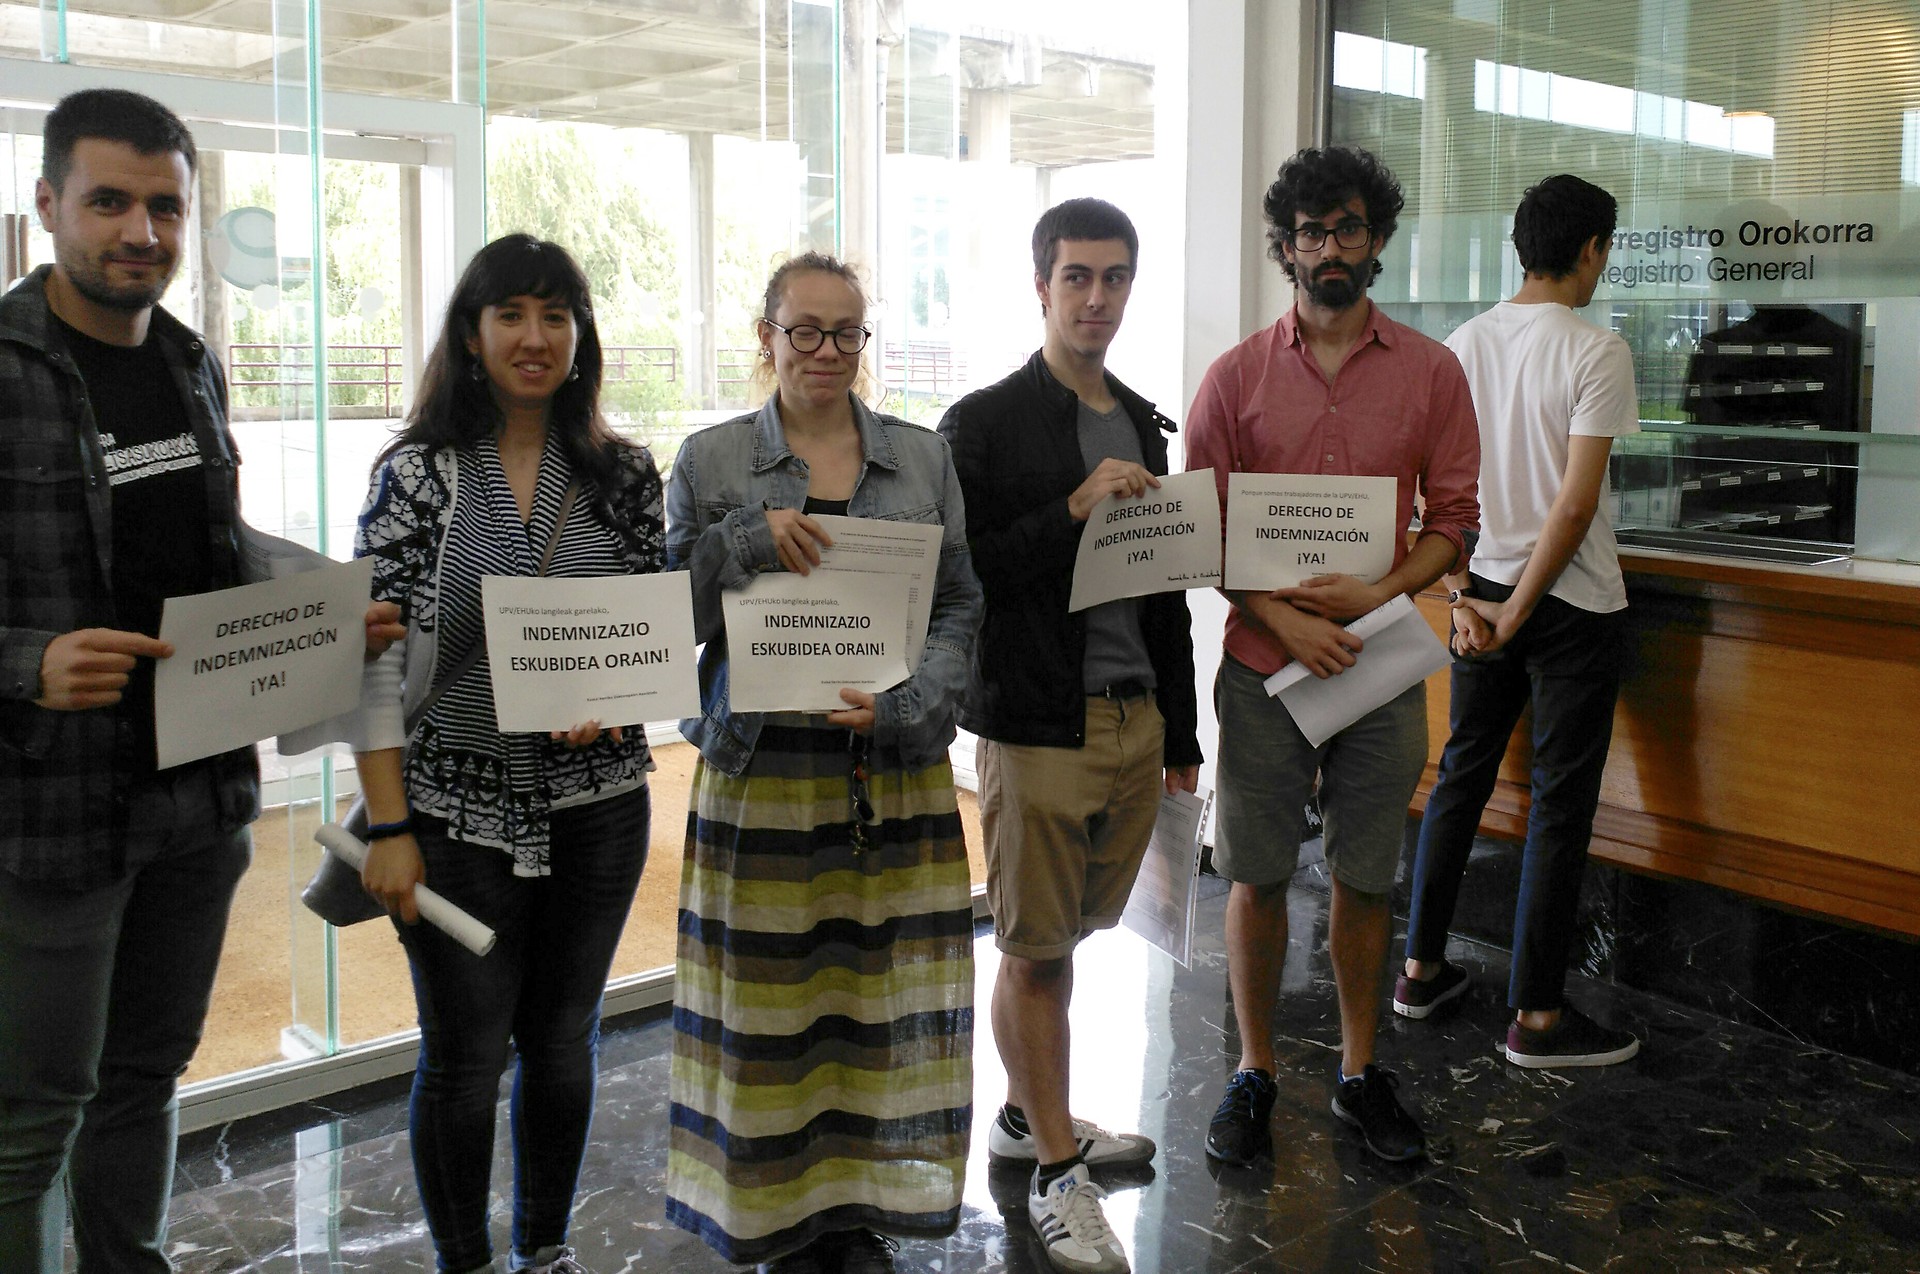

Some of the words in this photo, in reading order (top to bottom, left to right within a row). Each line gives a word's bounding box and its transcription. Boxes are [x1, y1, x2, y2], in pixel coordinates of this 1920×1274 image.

[1612, 225, 1725, 254] registro
[1739, 219, 1874, 247] Orokorra
[1707, 254, 1814, 282] General
[1105, 502, 1162, 524] DERECHO
[1165, 500, 1183, 514] DE
[1268, 504, 1332, 519] DERECHO
[1336, 507, 1355, 520] DE
[1094, 522, 1195, 550] INDEMNIZACIÓN
[1255, 527, 1369, 543] INDEMNIZACIÓN
[1127, 548, 1154, 566] ¡YA!
[1297, 552, 1326, 566] ¡YA!
[216, 607, 299, 638] DERECHO
[302, 601, 326, 619] DE
[499, 606, 540, 616] UPV/EHUko
[764, 614, 871, 630] INDEMNIZAZIO
[522, 621, 650, 641] INDEMNIZAZIO
[193, 627, 338, 675] INDEMNIZACIÓN
[510, 655, 601, 672] ESKUBIDEA
[604, 647, 670, 669] ORAIN!
[751, 642, 832, 657] ESKUBIDEA
[834, 641, 885, 656] ORAIN!
[250, 670, 286, 697] ¡YA!
